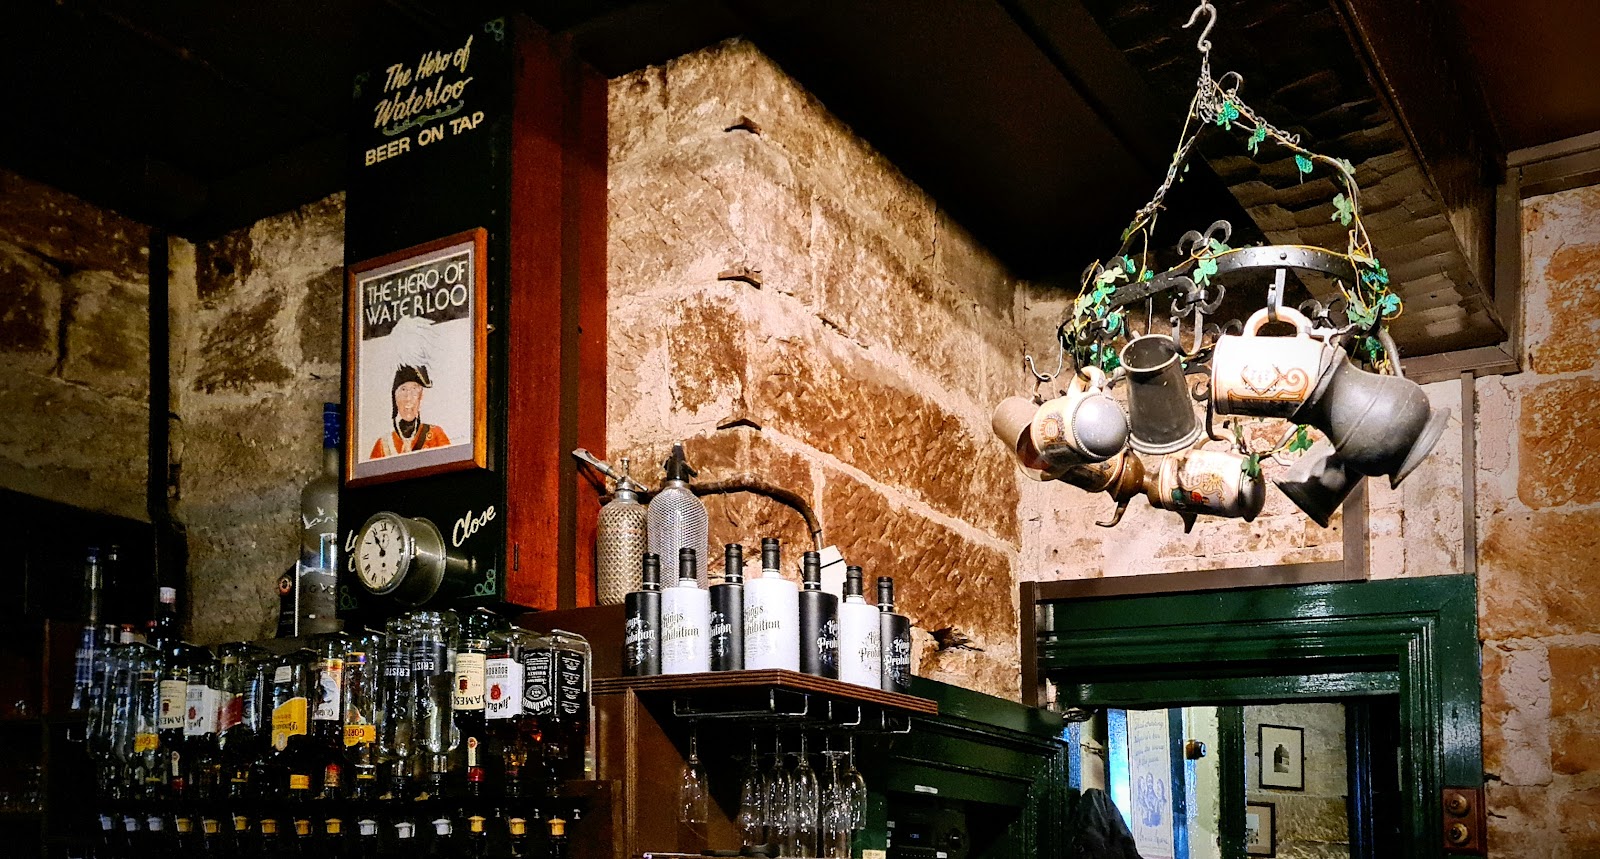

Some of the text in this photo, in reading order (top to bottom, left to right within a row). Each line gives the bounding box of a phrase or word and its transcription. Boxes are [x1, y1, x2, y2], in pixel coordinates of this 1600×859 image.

[384, 34, 473, 94] The Hero of
[374, 76, 473, 129] Waterloo
[365, 110, 485, 167] BEER ON TAP
[365, 283, 468, 326] WATERLOO
[366, 260, 468, 306] THE HERO OF
[451, 504, 497, 548] Close
[453, 694, 486, 706] JAMES
